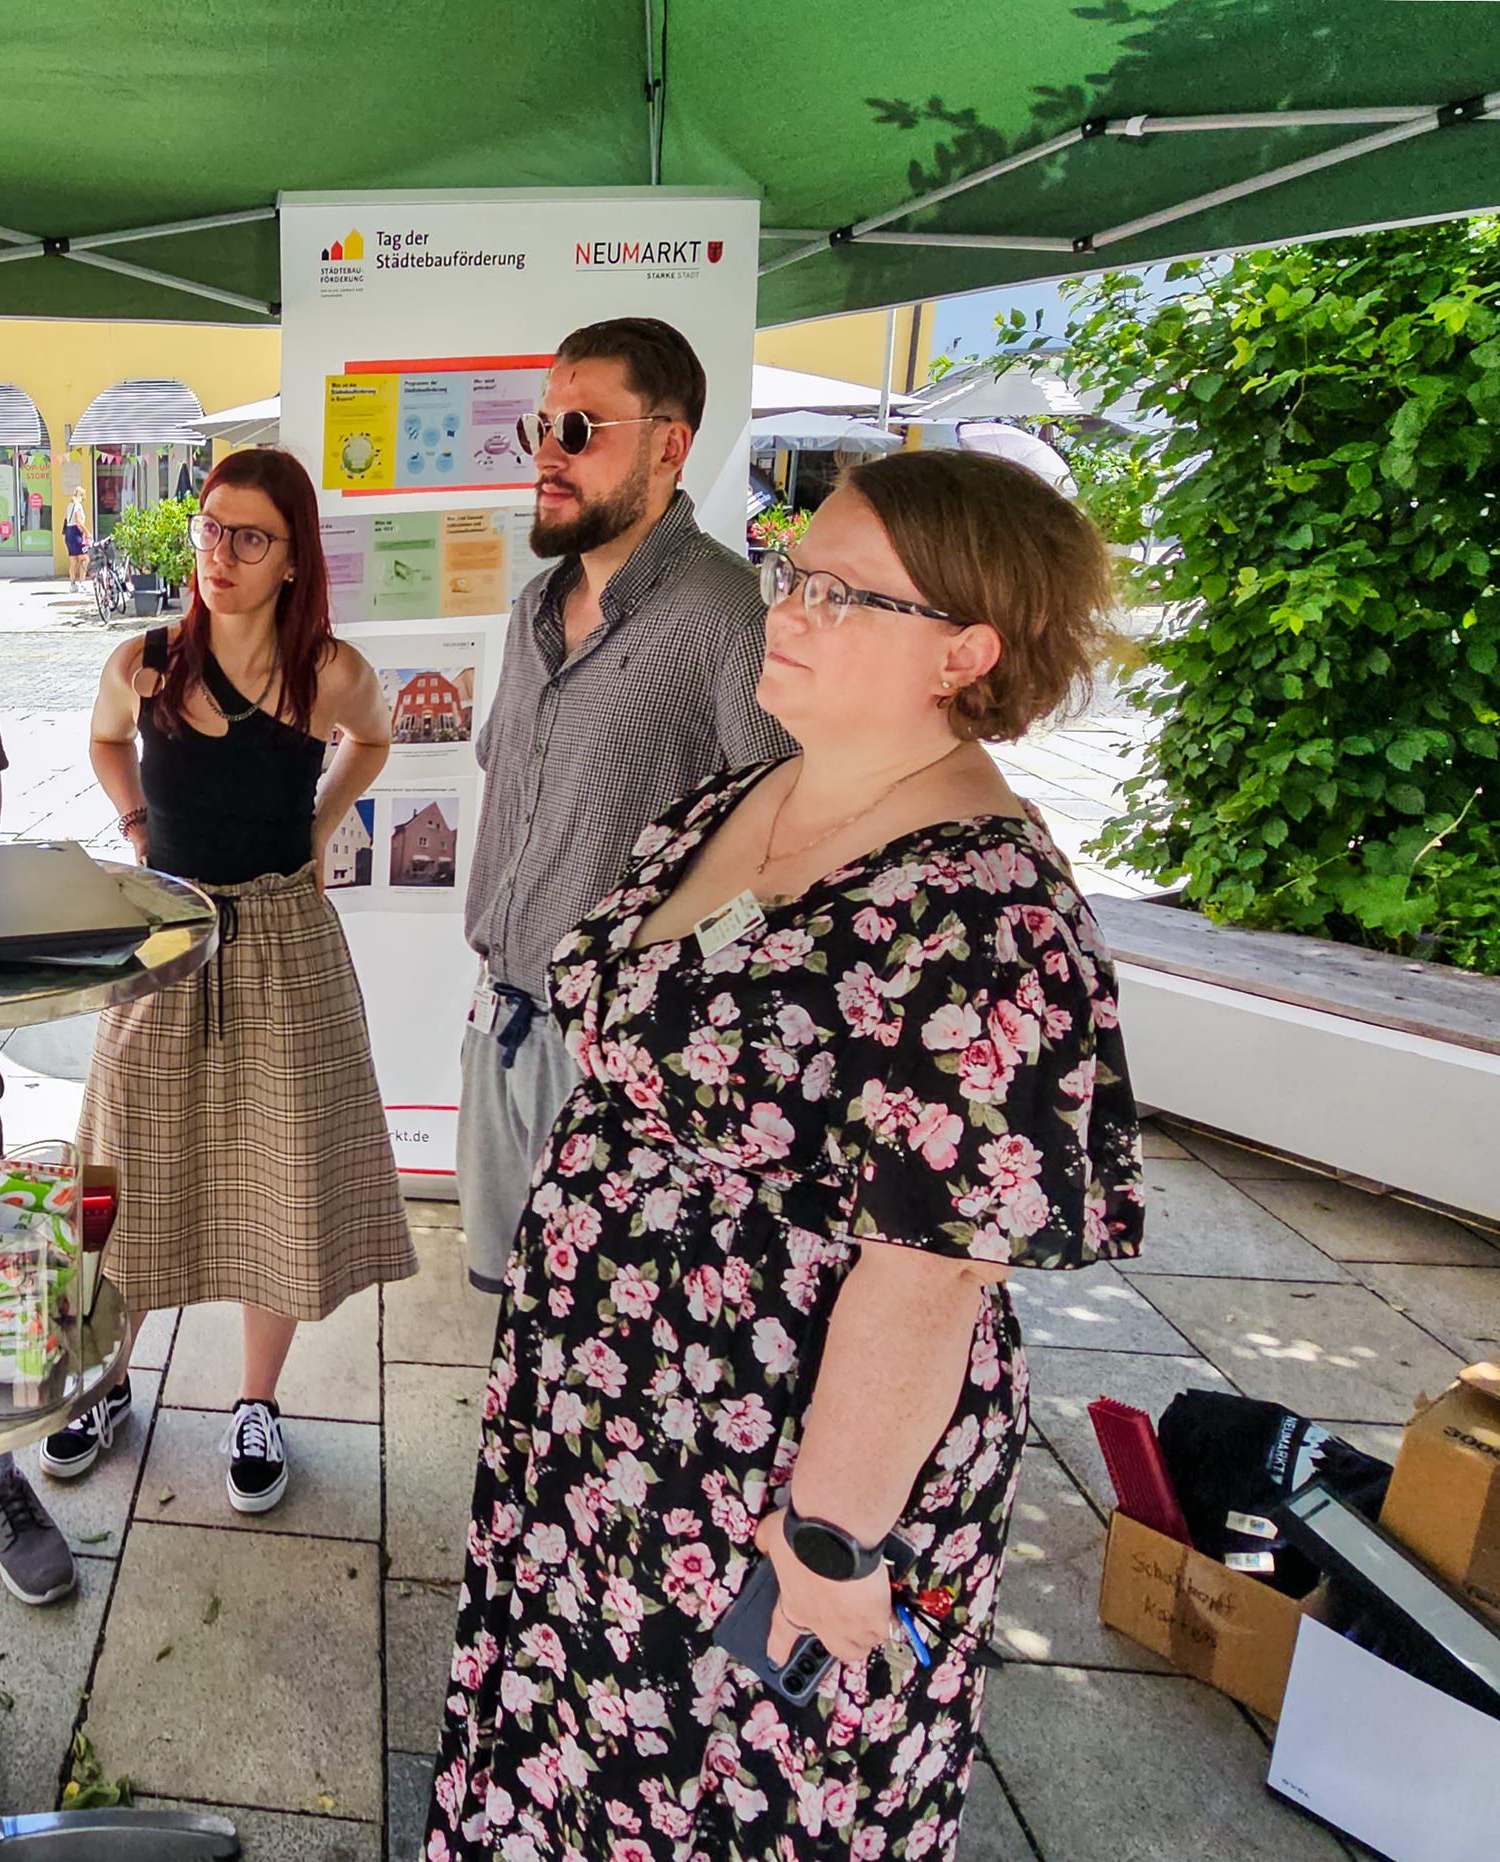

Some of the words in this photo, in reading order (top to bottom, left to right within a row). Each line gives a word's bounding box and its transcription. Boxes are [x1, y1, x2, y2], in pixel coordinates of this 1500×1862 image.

[376, 231, 401, 250] Tag
[405, 230, 430, 246] der
[376, 251, 526, 270] Städtebauförderung
[575, 241, 702, 265] NEUMARKT
[320, 275, 364, 284] FÖRDERUNG
[1273, 1415, 1299, 1474] NEUMARKT
